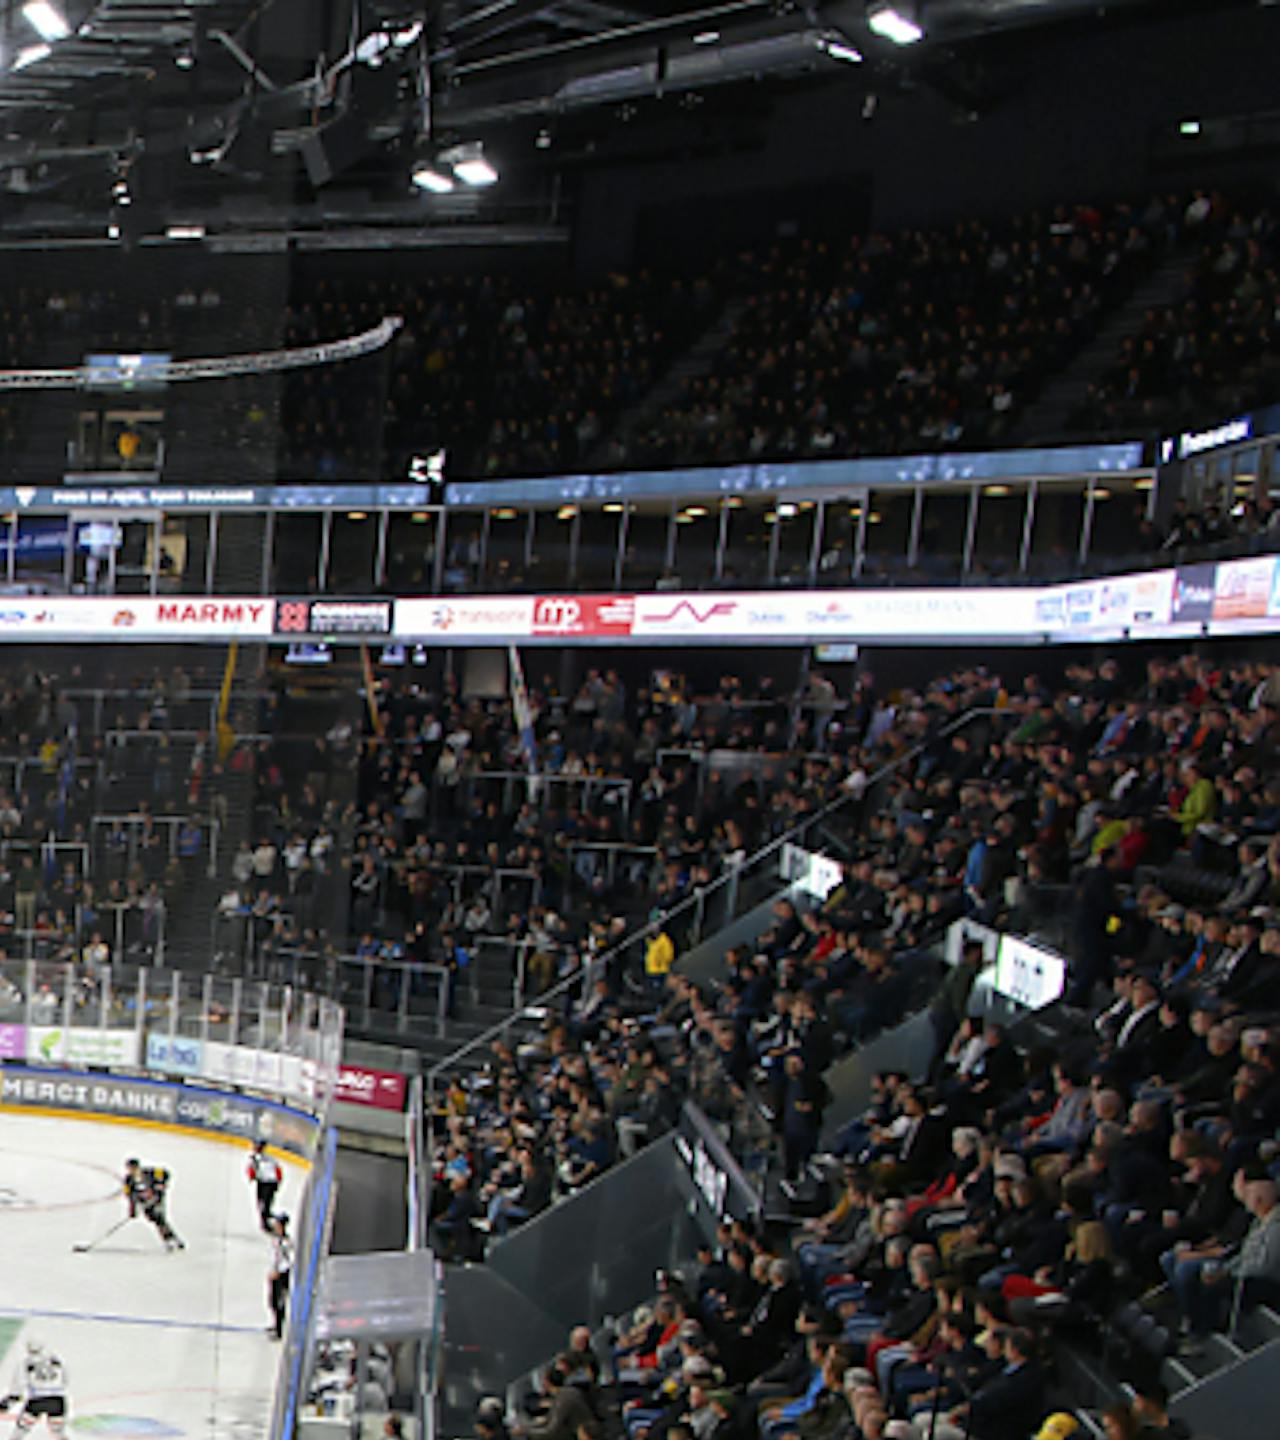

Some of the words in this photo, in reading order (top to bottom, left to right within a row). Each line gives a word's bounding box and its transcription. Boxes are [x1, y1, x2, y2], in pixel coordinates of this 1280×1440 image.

[156, 602, 265, 624] MARMY
[2, 1078, 87, 1101] MERCI
[92, 1088, 173, 1114] DANKE
